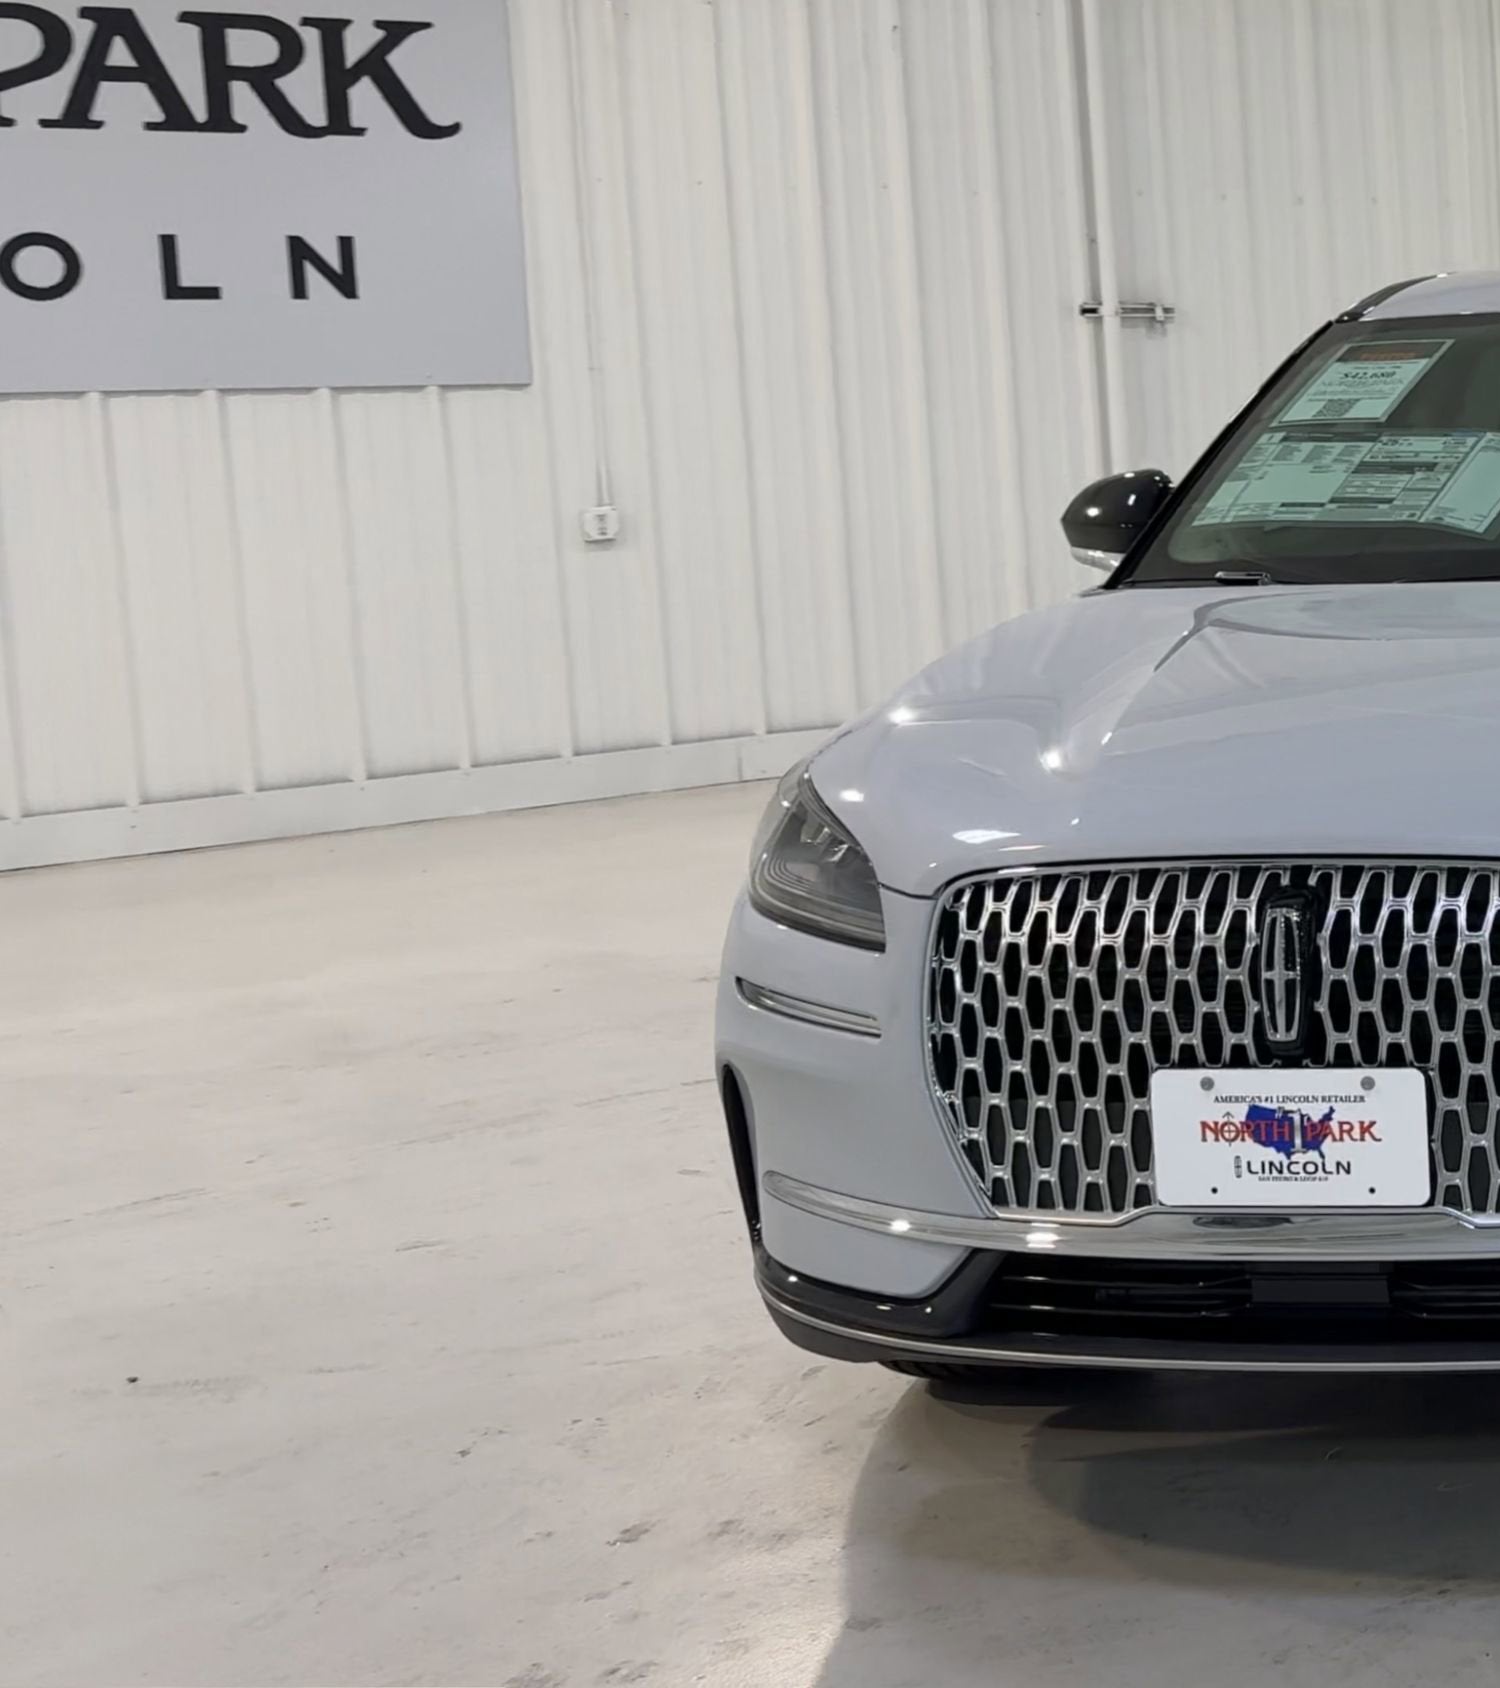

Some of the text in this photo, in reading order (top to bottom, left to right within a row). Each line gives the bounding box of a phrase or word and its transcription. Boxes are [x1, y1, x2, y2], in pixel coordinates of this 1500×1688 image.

[0, 231, 360, 301] OLN
[1213, 1094, 1262, 1104] AMERICA'S
[1276, 1094, 1319, 1104] LINCOLN
[1321, 1094, 1366, 1104] RETAILER
[1200, 1119, 1382, 1143] NORTH PARK
[1246, 1160, 1351, 1175] LINCOLN
